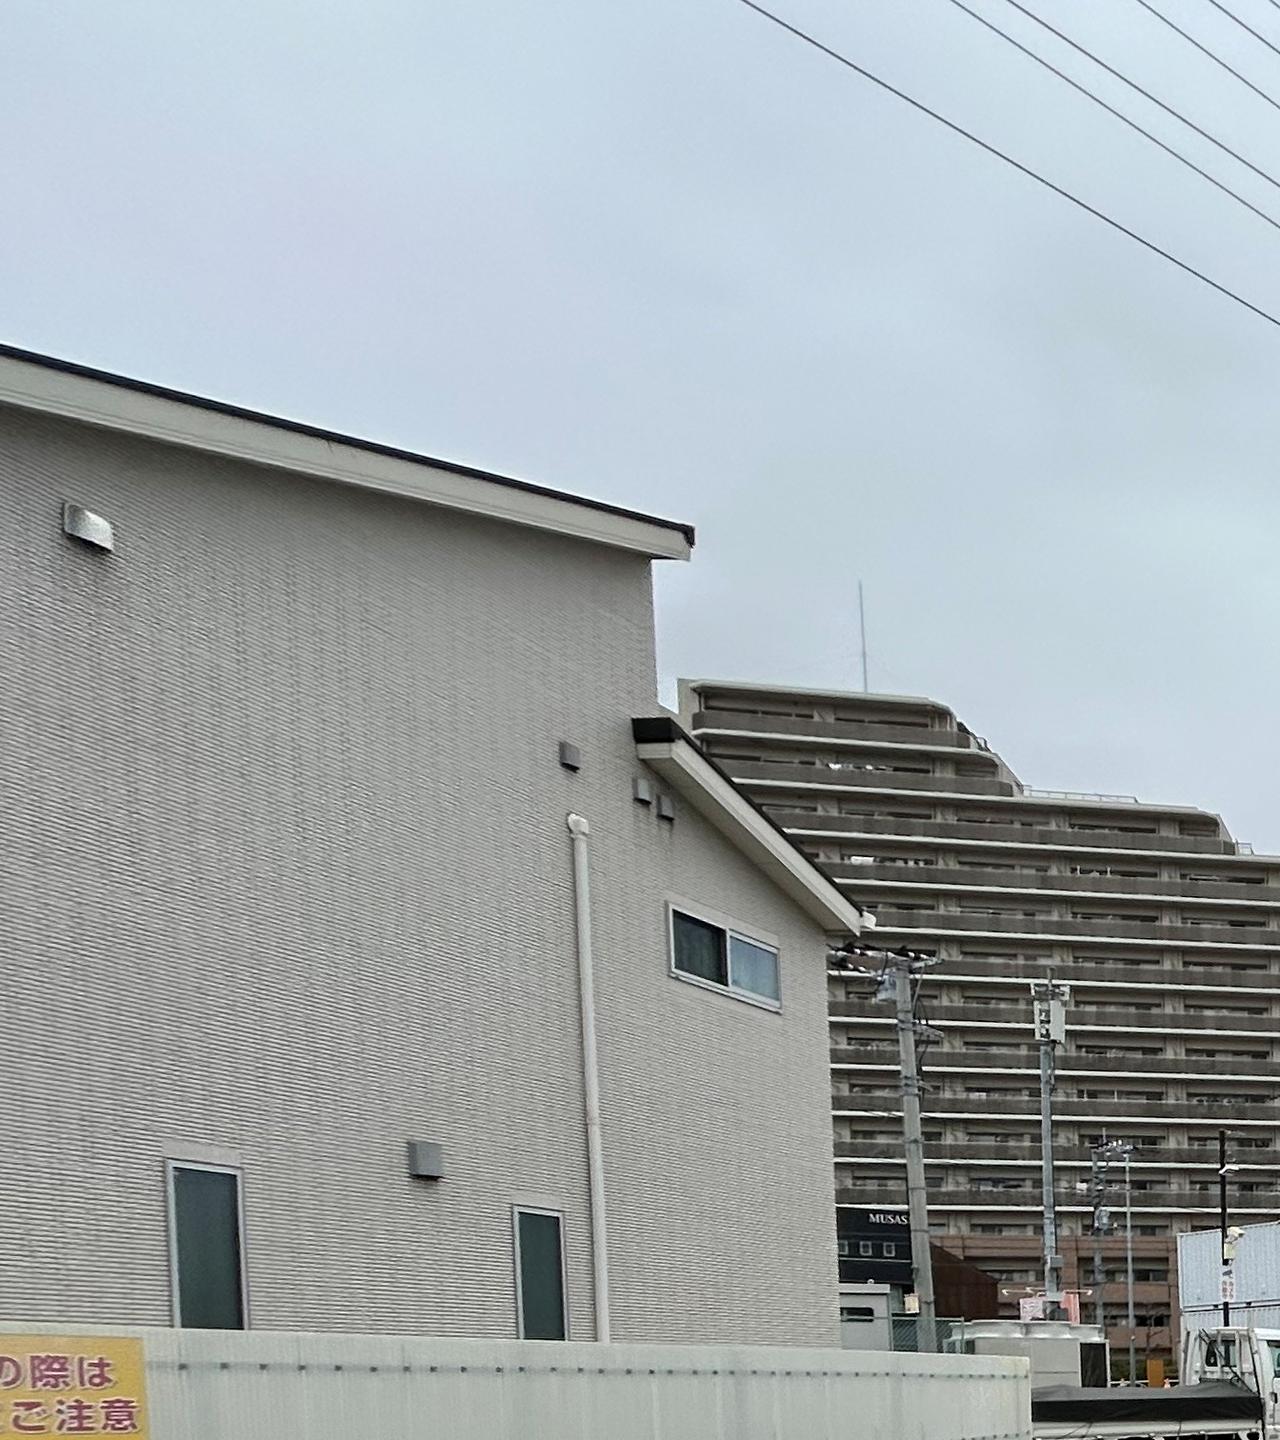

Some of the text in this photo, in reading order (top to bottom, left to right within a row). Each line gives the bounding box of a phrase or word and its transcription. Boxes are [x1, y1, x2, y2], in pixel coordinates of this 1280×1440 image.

[868, 1213, 909, 1225] MUSAS
[11, 1398, 139, 1433] ご注意
